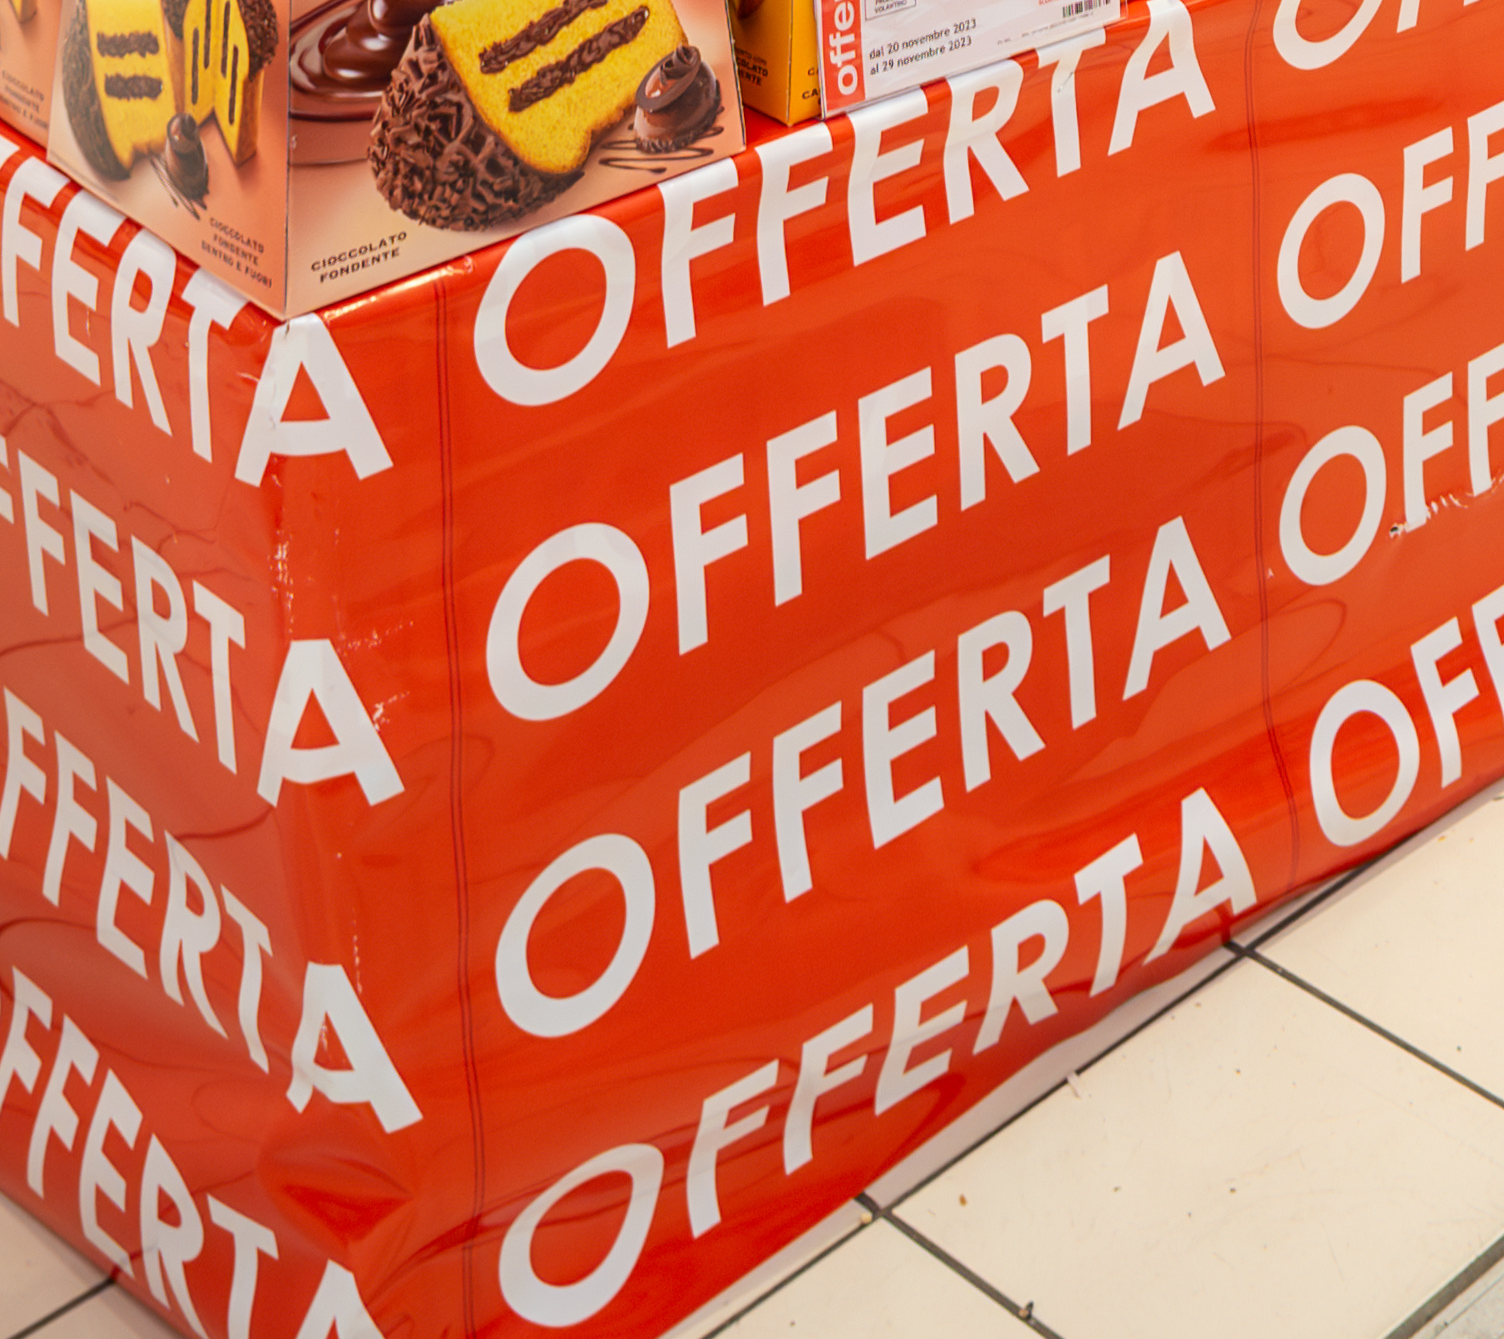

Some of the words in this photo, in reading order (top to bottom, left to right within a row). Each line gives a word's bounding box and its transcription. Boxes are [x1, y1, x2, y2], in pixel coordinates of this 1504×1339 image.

[310, 230, 408, 273] CIOCCOLATO
[320, 247, 401, 284] FONDENTE
[486, 251, 1226, 723] OFFERTA
[496, 515, 1231, 1038] OFFERTA
[498, 788, 1258, 1328] OFFERTA
